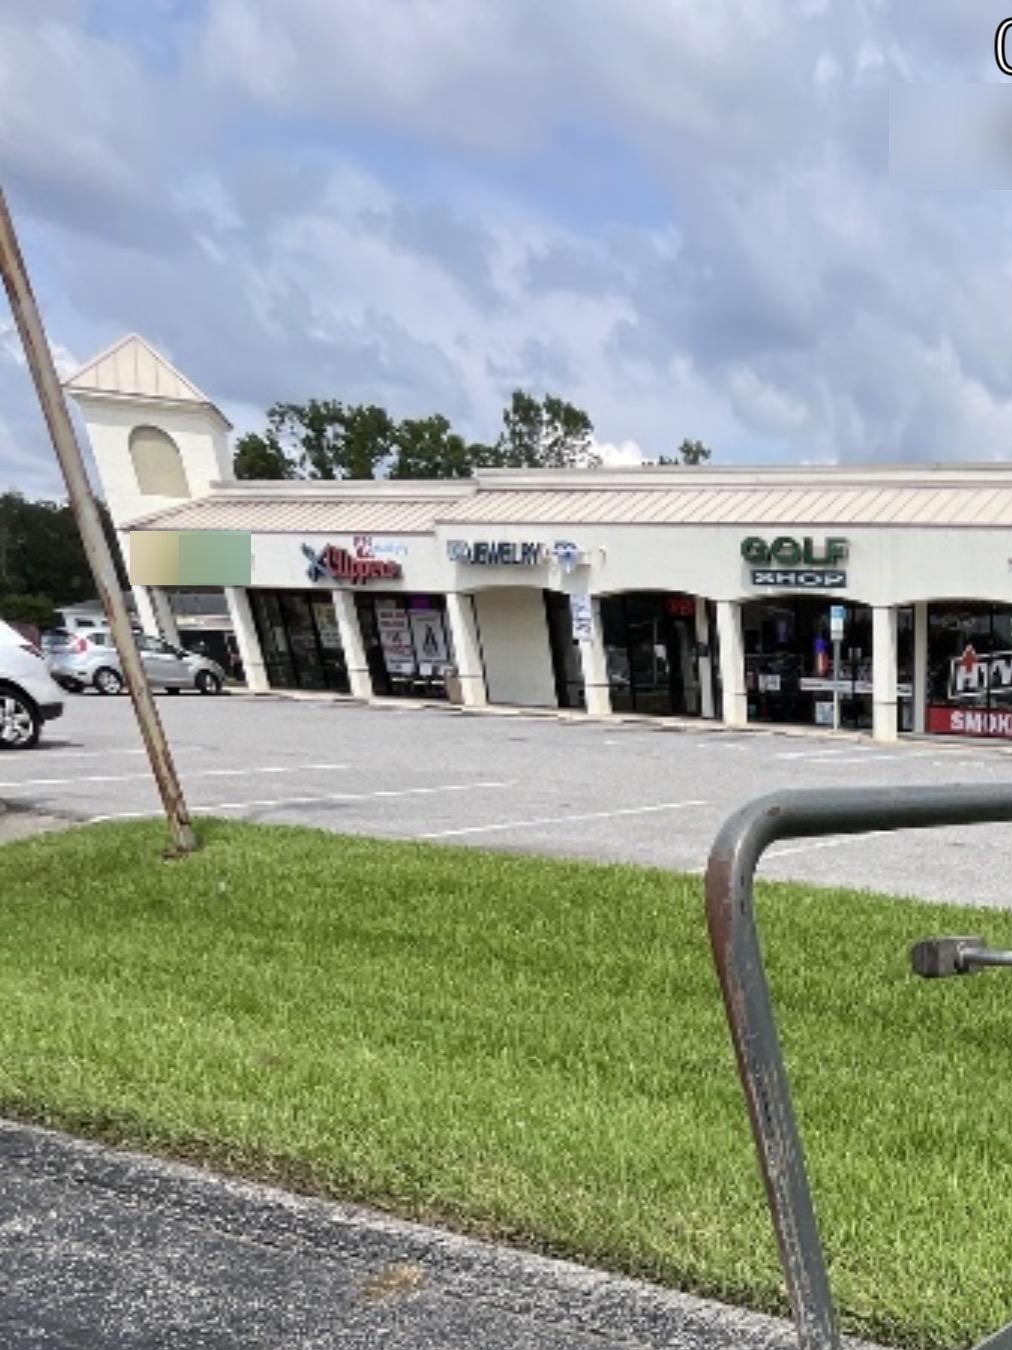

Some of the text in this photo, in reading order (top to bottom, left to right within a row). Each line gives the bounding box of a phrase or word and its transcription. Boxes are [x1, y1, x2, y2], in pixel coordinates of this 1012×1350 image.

[470, 541, 543, 565] JEWELRY
[740, 537, 849, 566] GOLF
[754, 571, 844, 585] SHOP
